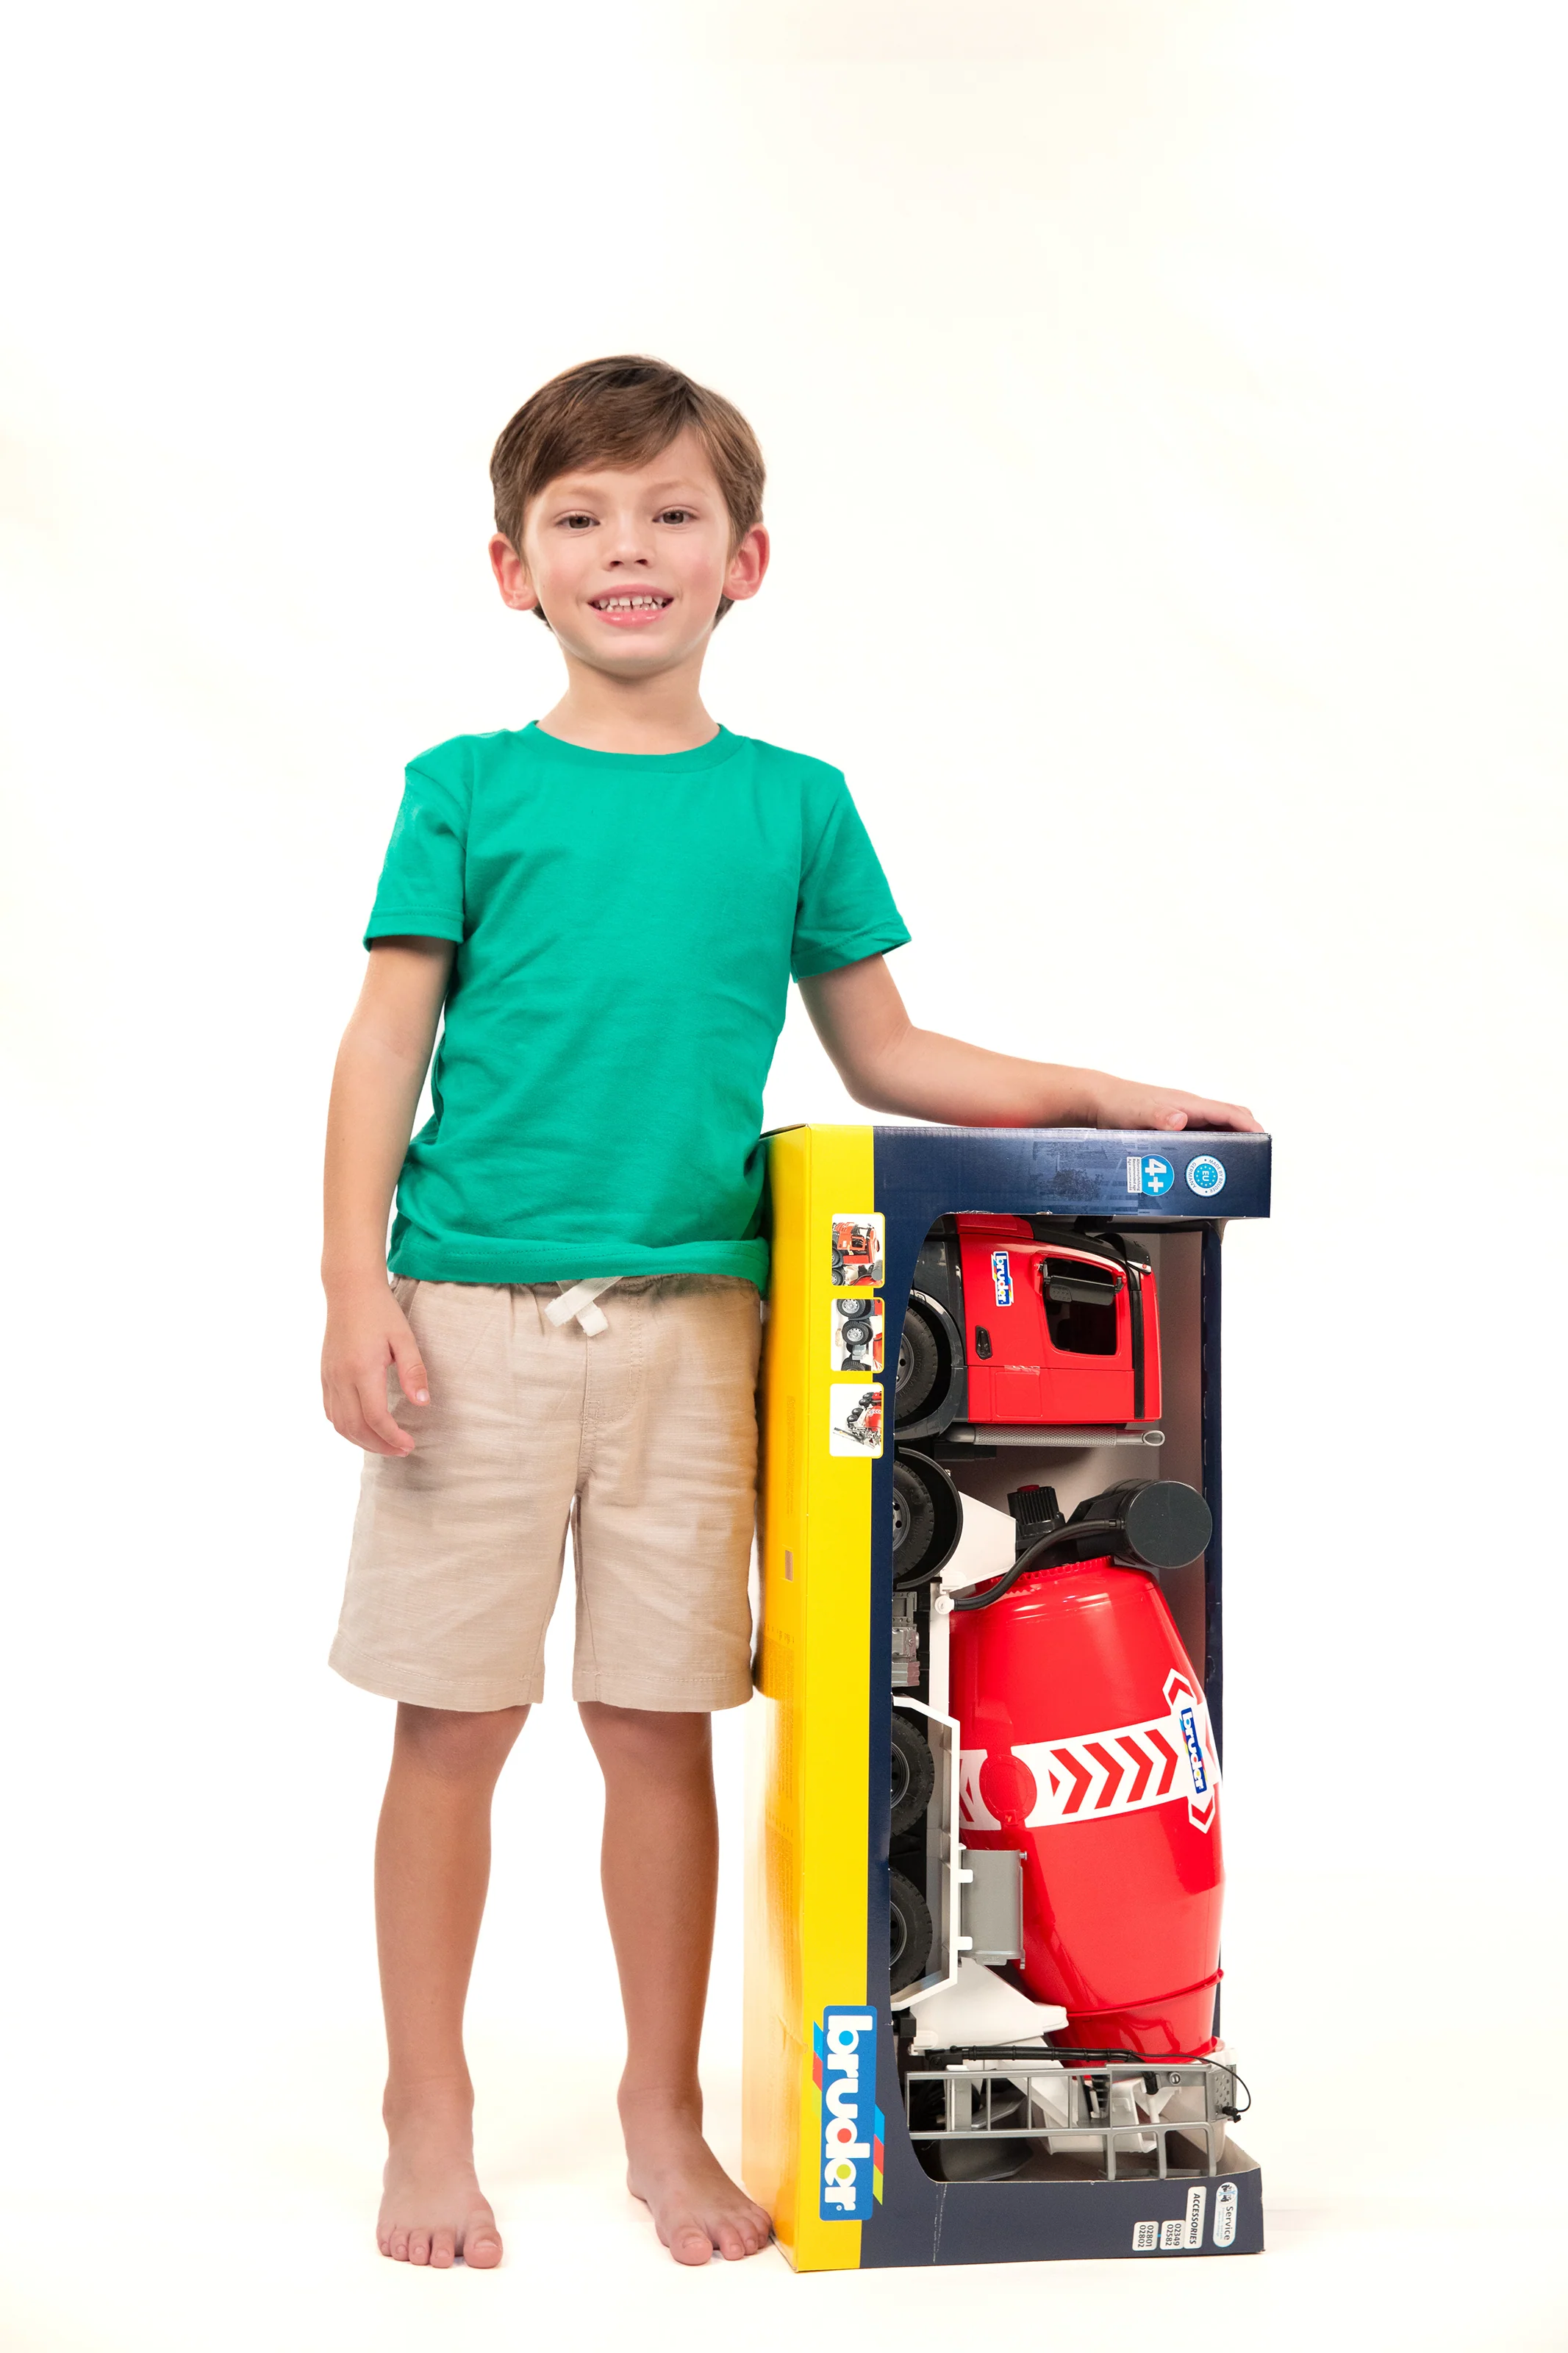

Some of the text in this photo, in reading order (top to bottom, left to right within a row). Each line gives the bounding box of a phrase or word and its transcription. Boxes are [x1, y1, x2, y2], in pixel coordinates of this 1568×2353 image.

[1145, 1158, 1167, 1193] 4+
[1188, 1162, 1197, 1188] GERMANY
[1202, 1171, 1209, 1182] EU
[1209, 1160, 1221, 1170] MADE
[1209, 1178, 1223, 1193] BRUDER
[995, 1255, 1009, 1302] bruder
[1182, 1712, 1204, 1789] bruder
[824, 2015, 873, 2211] bruder
[1189, 2193, 1200, 2245] ACCESSORIES
[1223, 2206, 1234, 2240] Service
[1137, 2224, 1146, 2248] 02802
[1145, 2224, 1154, 2247] 02801
[1165, 2224, 1174, 2246] 02582
[1173, 2223, 1182, 2246] 02349
